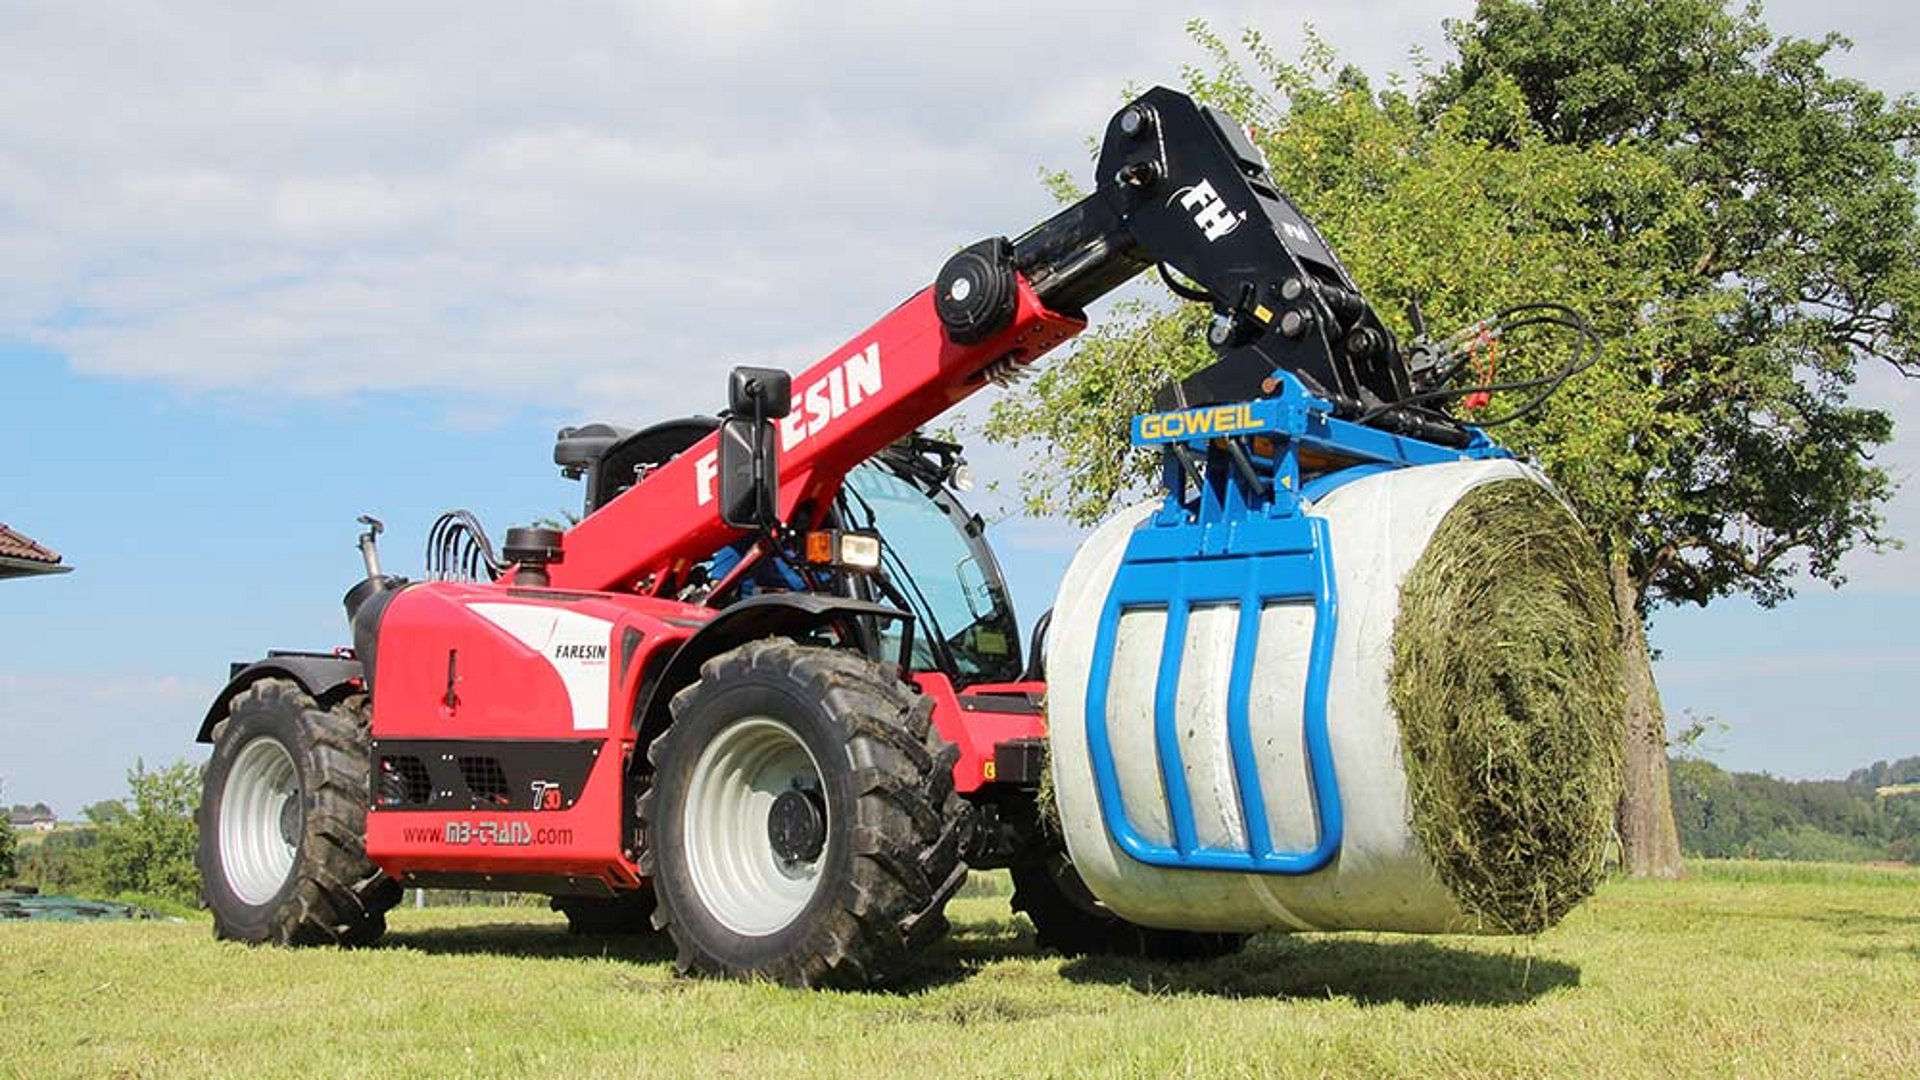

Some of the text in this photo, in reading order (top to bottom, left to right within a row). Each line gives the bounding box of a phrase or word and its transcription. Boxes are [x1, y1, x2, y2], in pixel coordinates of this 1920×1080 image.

[694, 342, 884, 507] FESIN
[555, 645, 607, 659] FARESIN
[531, 781, 561, 810] 730
